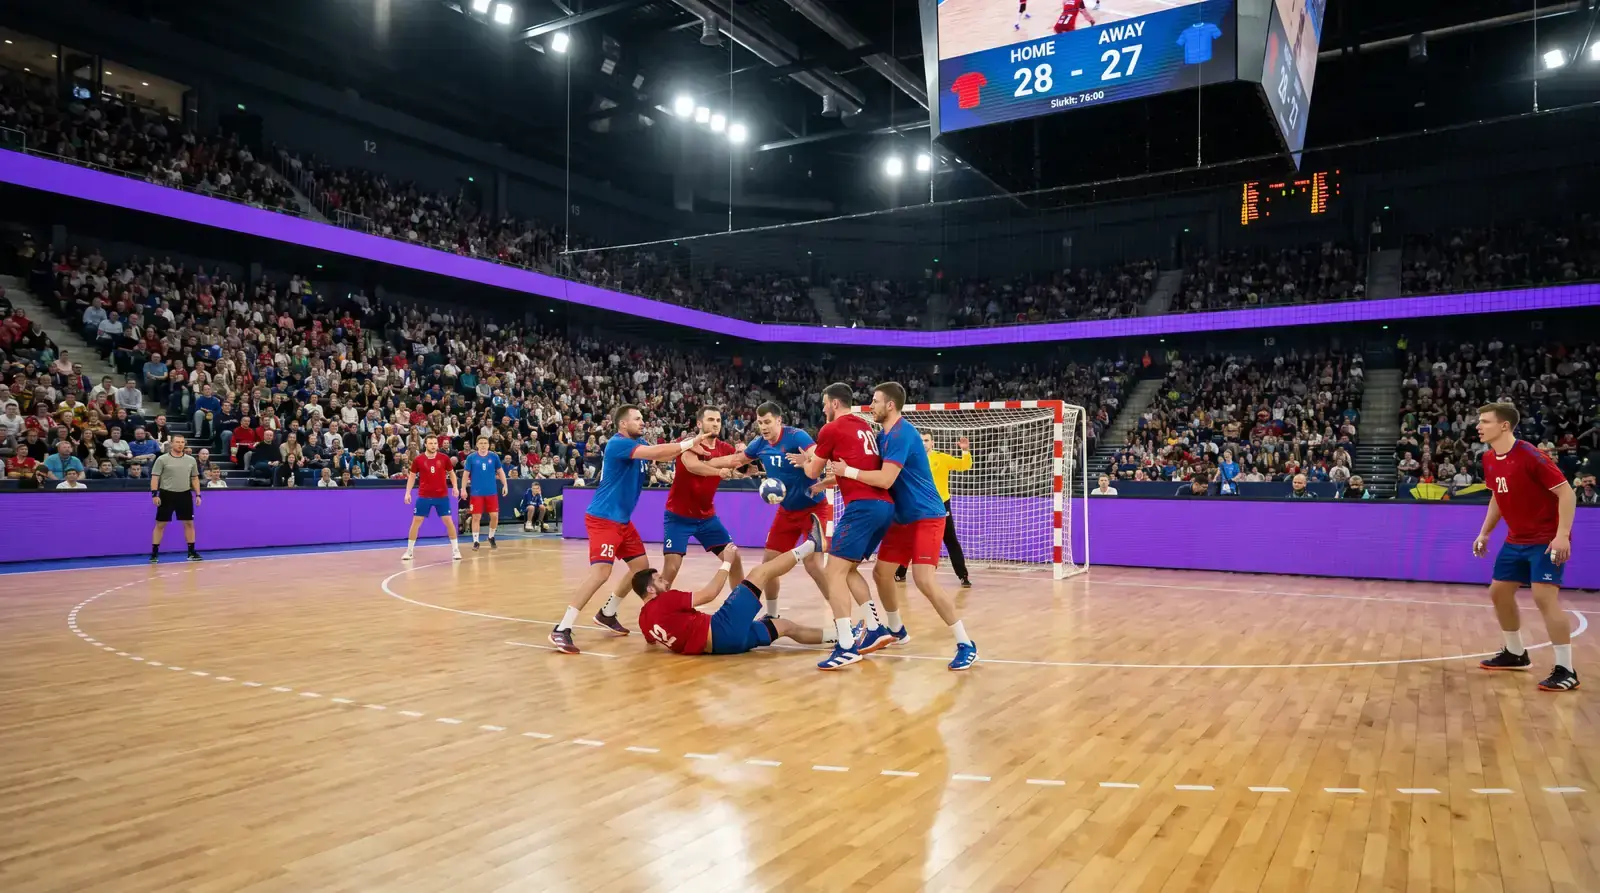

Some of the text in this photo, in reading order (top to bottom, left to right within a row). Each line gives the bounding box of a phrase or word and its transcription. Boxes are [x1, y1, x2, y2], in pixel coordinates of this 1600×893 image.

[1010, 21, 1146, 63] HOME AWAY
[1013, 63, 1053, 98] 28
[1100, 44, 1143, 81] 27
[1079, 90, 1105, 103] 76:00
[363, 139, 377, 154] 12
[857, 429, 880, 456] 20
[600, 543, 615, 558] 25
